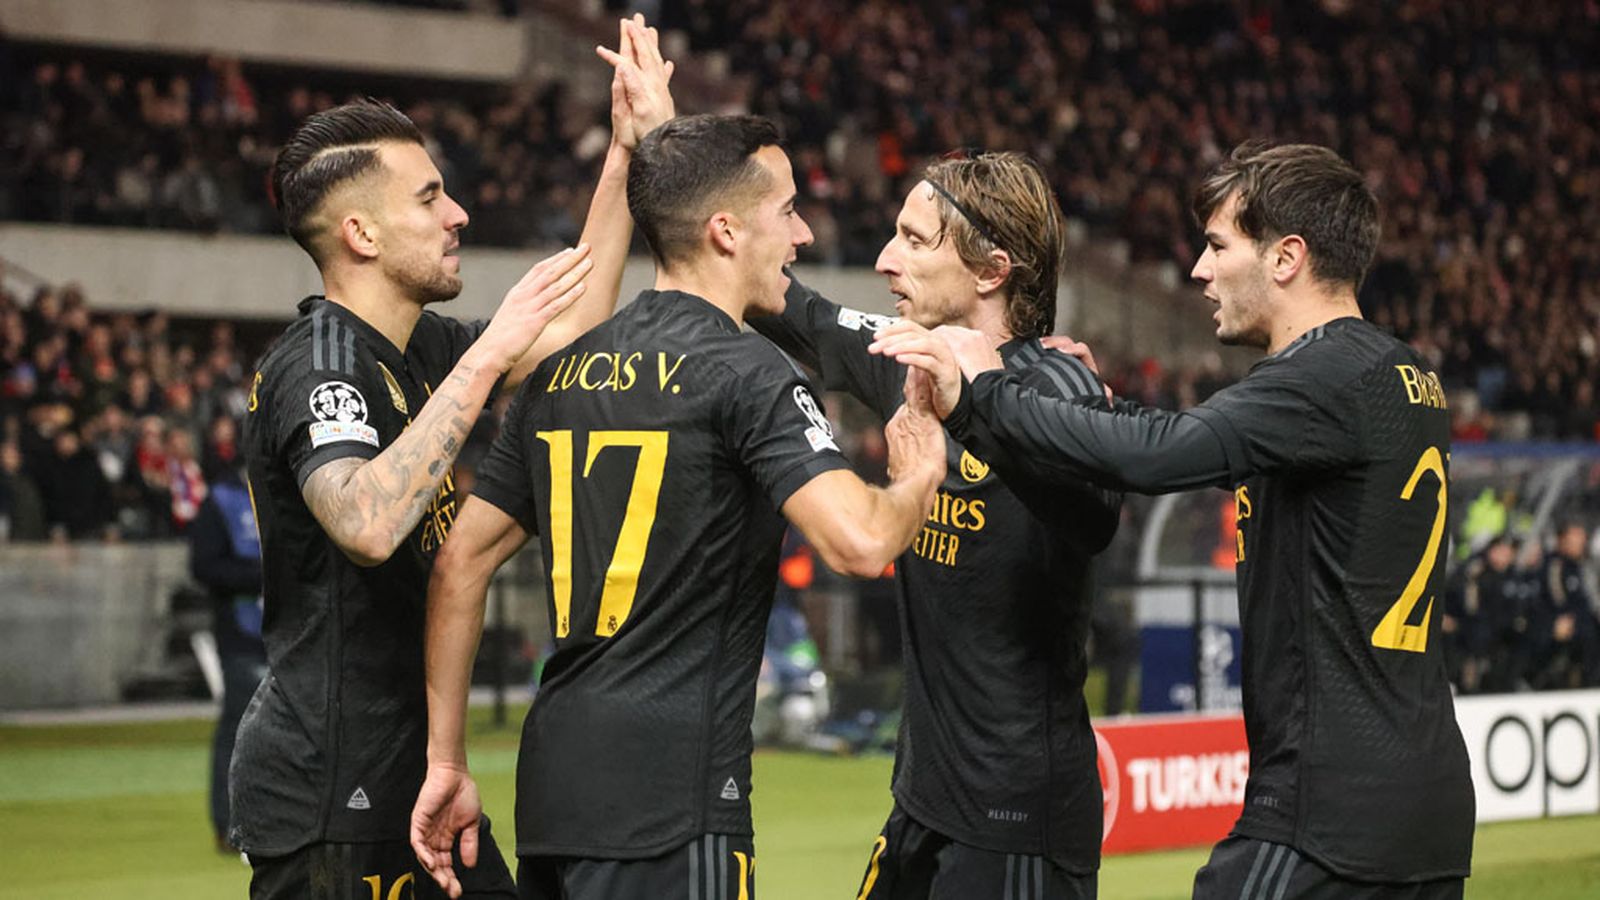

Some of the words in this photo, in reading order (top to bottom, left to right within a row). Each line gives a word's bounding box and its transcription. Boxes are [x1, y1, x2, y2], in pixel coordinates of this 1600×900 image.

[546, 351, 642, 393] LUCAS
[657, 351, 687, 394] V.
[535, 429, 669, 638] 17
[913, 527, 960, 567] ETTER
[1371, 446, 1450, 653] 2
[1127, 750, 1249, 813] TURKIS
[1485, 711, 1600, 818] op
